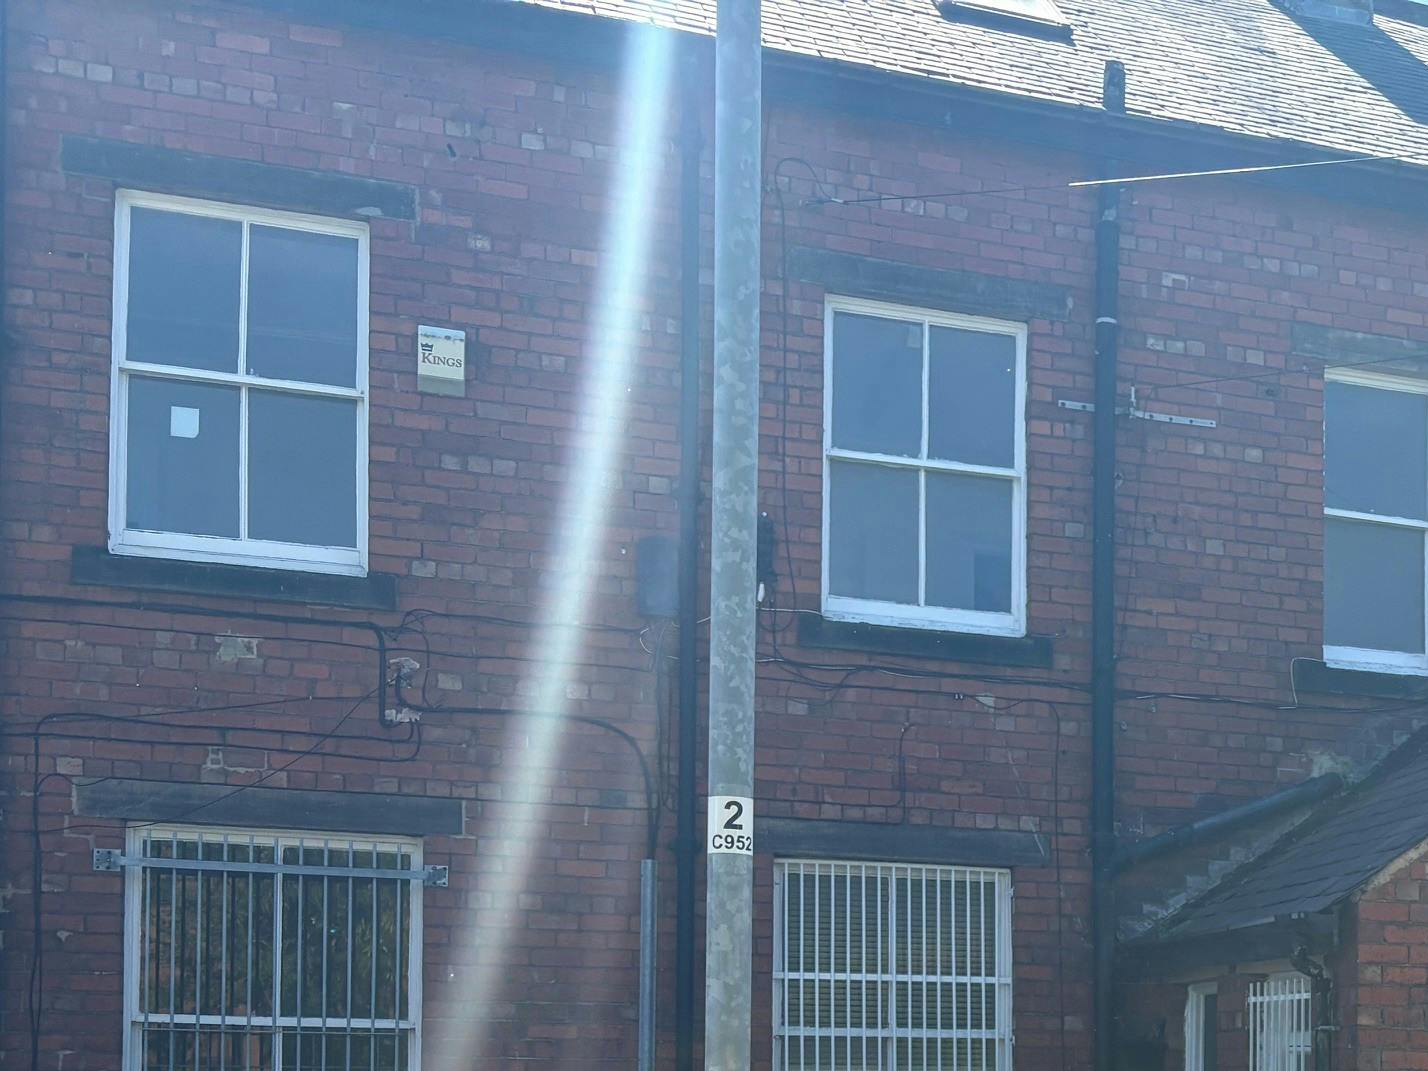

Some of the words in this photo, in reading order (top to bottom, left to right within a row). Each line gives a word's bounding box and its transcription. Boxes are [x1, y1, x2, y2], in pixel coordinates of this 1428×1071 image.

[421, 351, 463, 368] KINGS
[723, 800, 743, 830] 2
[712, 834, 752, 851] C952
